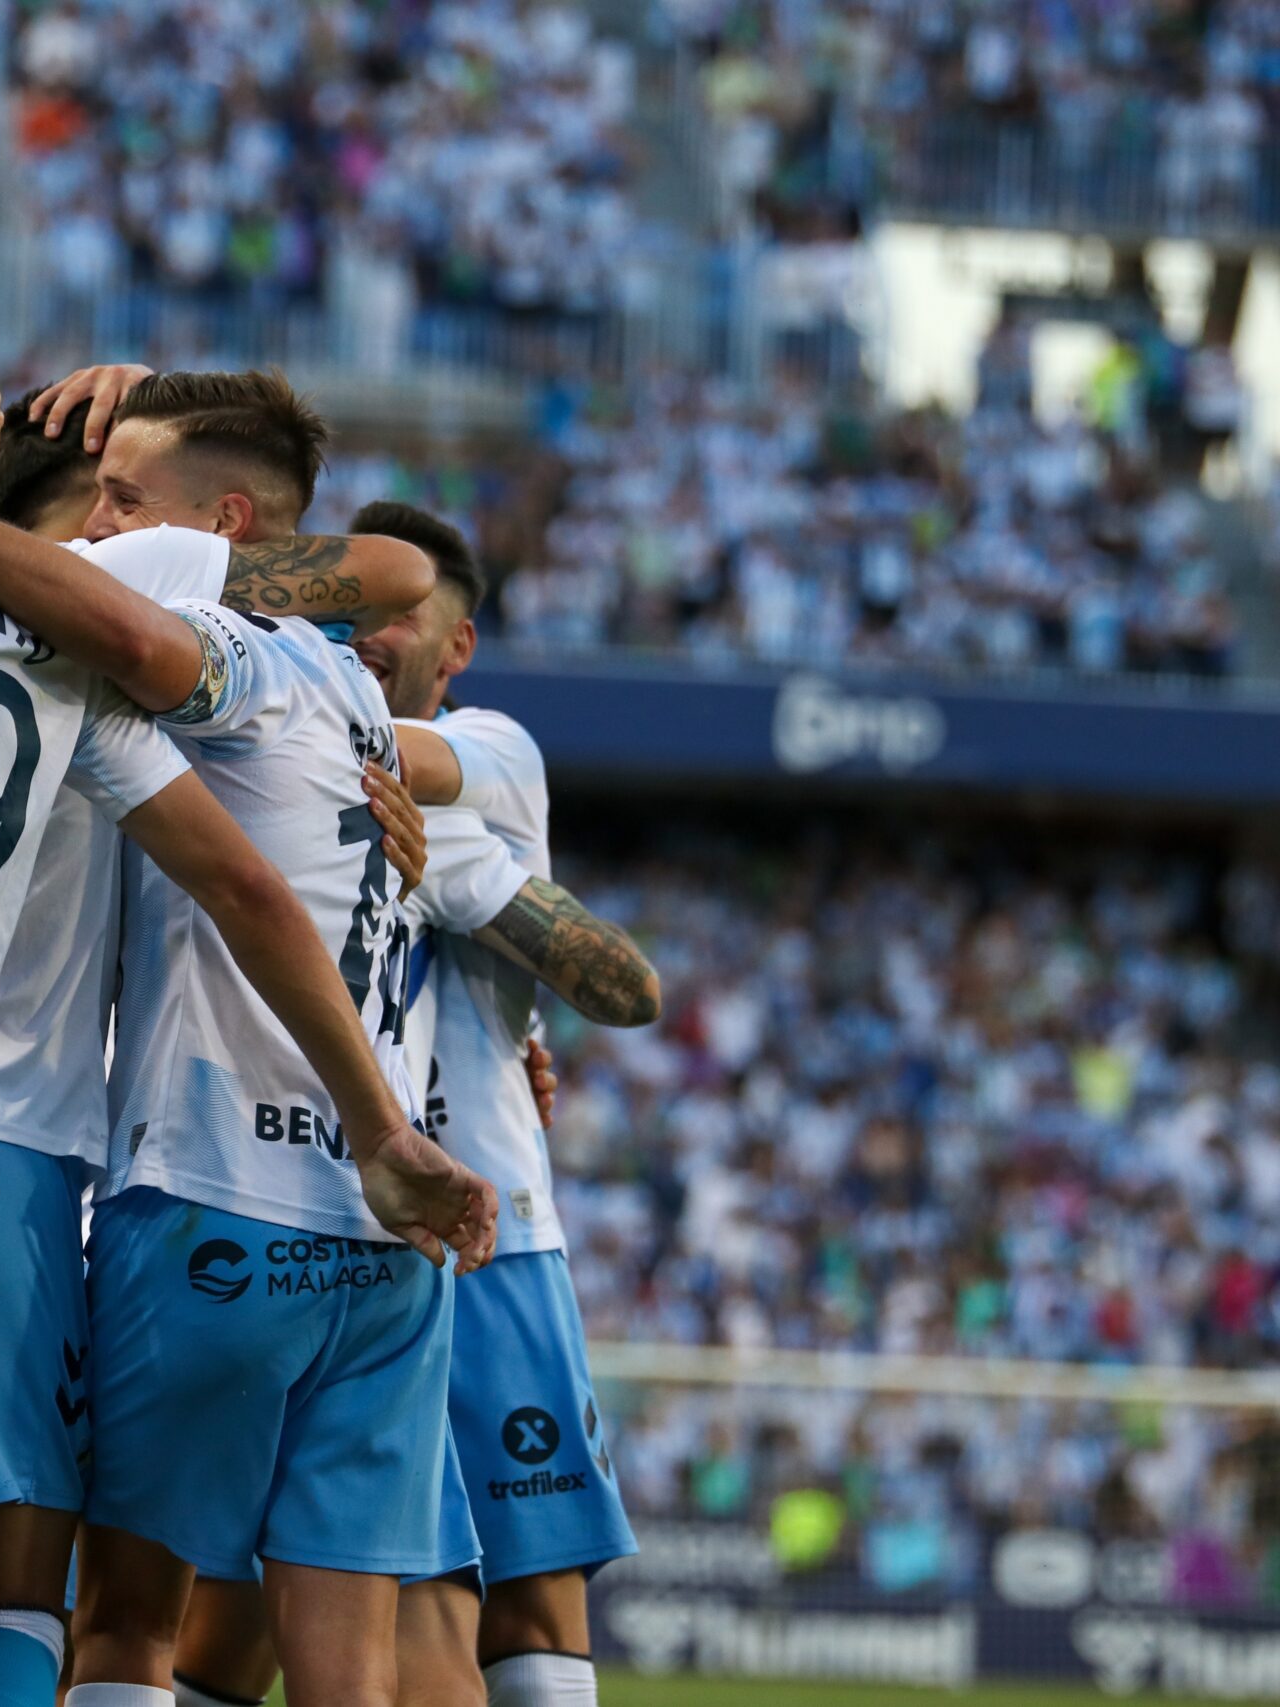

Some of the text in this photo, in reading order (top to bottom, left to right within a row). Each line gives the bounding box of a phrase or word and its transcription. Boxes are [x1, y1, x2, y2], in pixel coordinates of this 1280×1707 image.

[255, 1102, 354, 1160] BEN
[267, 1262, 394, 1297] MÁLAGA
[487, 1470, 588, 1501] trafilex
